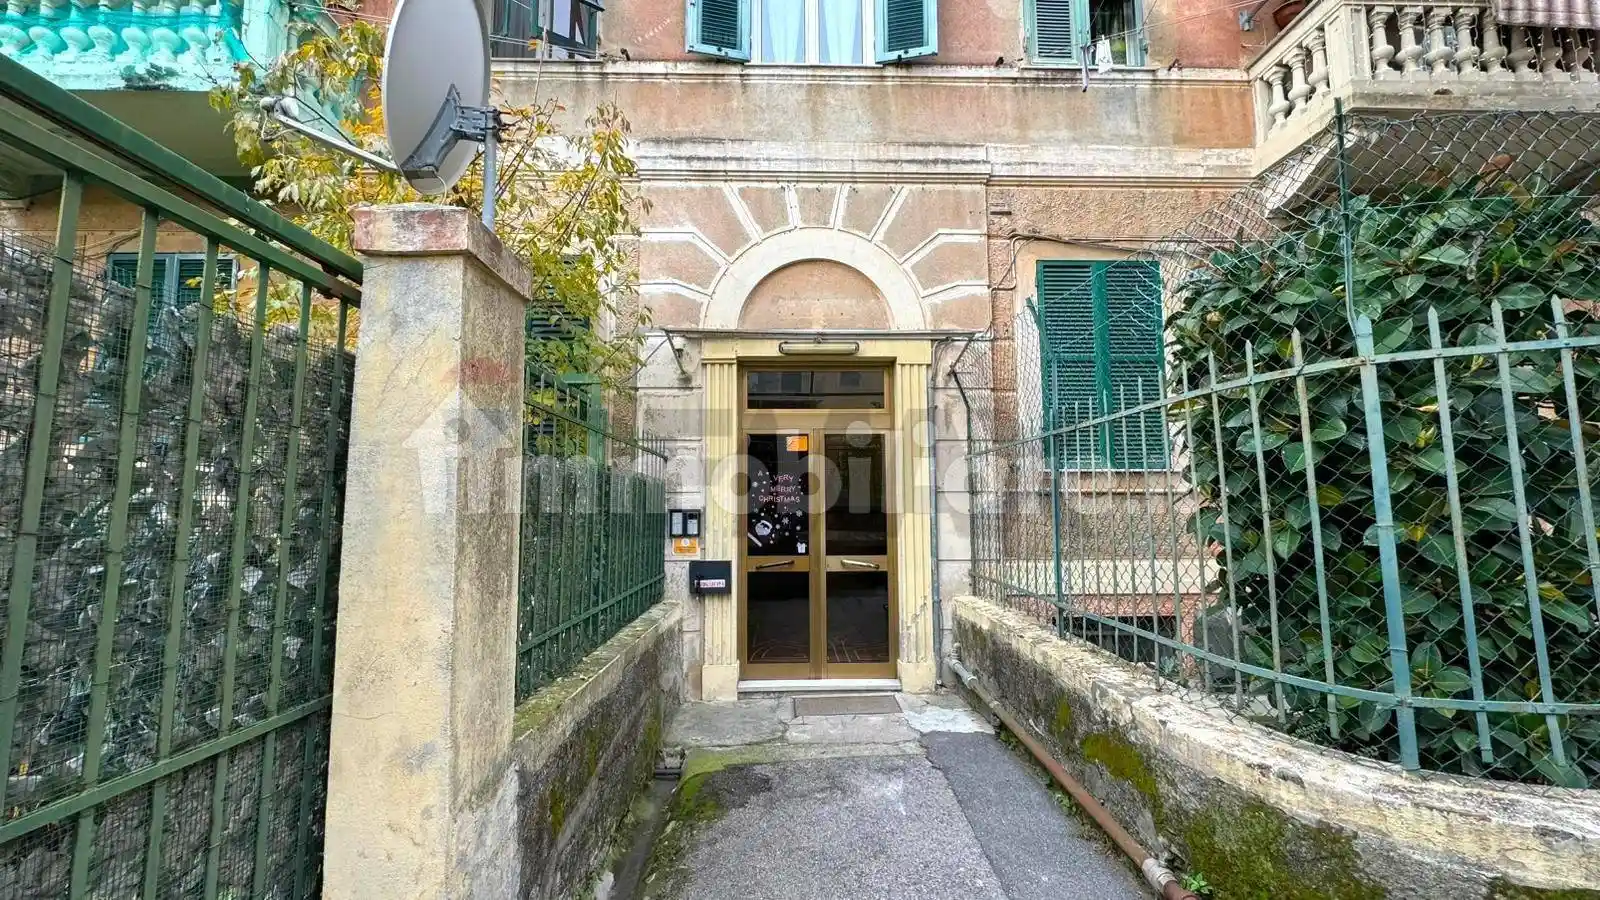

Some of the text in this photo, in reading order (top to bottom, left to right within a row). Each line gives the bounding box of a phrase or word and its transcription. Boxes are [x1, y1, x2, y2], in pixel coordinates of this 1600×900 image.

[773, 474, 795, 483] VERY
[770, 485, 797, 494] MERRY
[758, 495, 801, 504] CHRISTMAS
